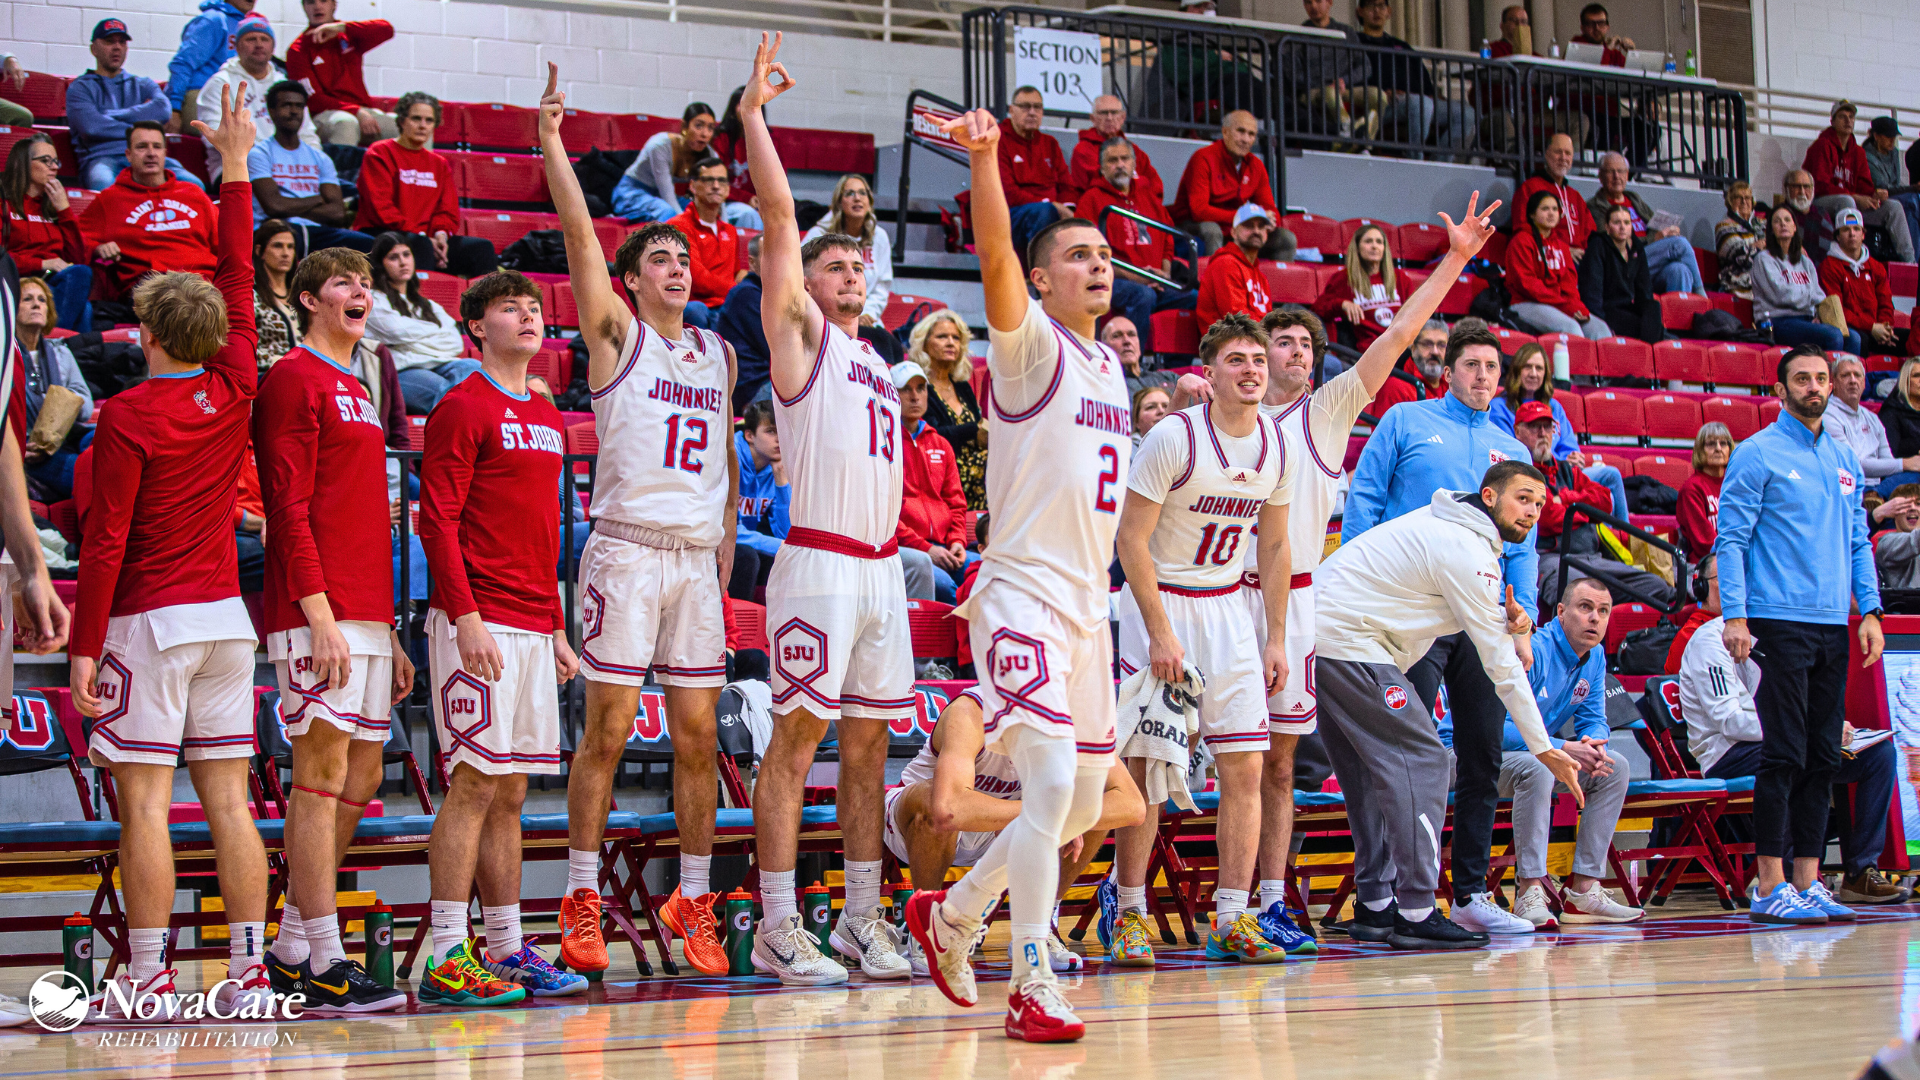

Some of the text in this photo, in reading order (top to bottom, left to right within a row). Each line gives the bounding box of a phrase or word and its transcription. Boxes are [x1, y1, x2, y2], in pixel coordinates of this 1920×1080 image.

[1019, 40, 1099, 65] SECTION
[1040, 70, 1081, 96] 103
[663, 412, 709, 475] 12
[865, 397, 895, 464] 13
[1094, 443, 1119, 515] 2
[1189, 495, 1267, 518] JOHNNIE
[1193, 522, 1244, 566] 10
[784, 645, 815, 662] SJU
[1386, 691, 1406, 705] SJU
